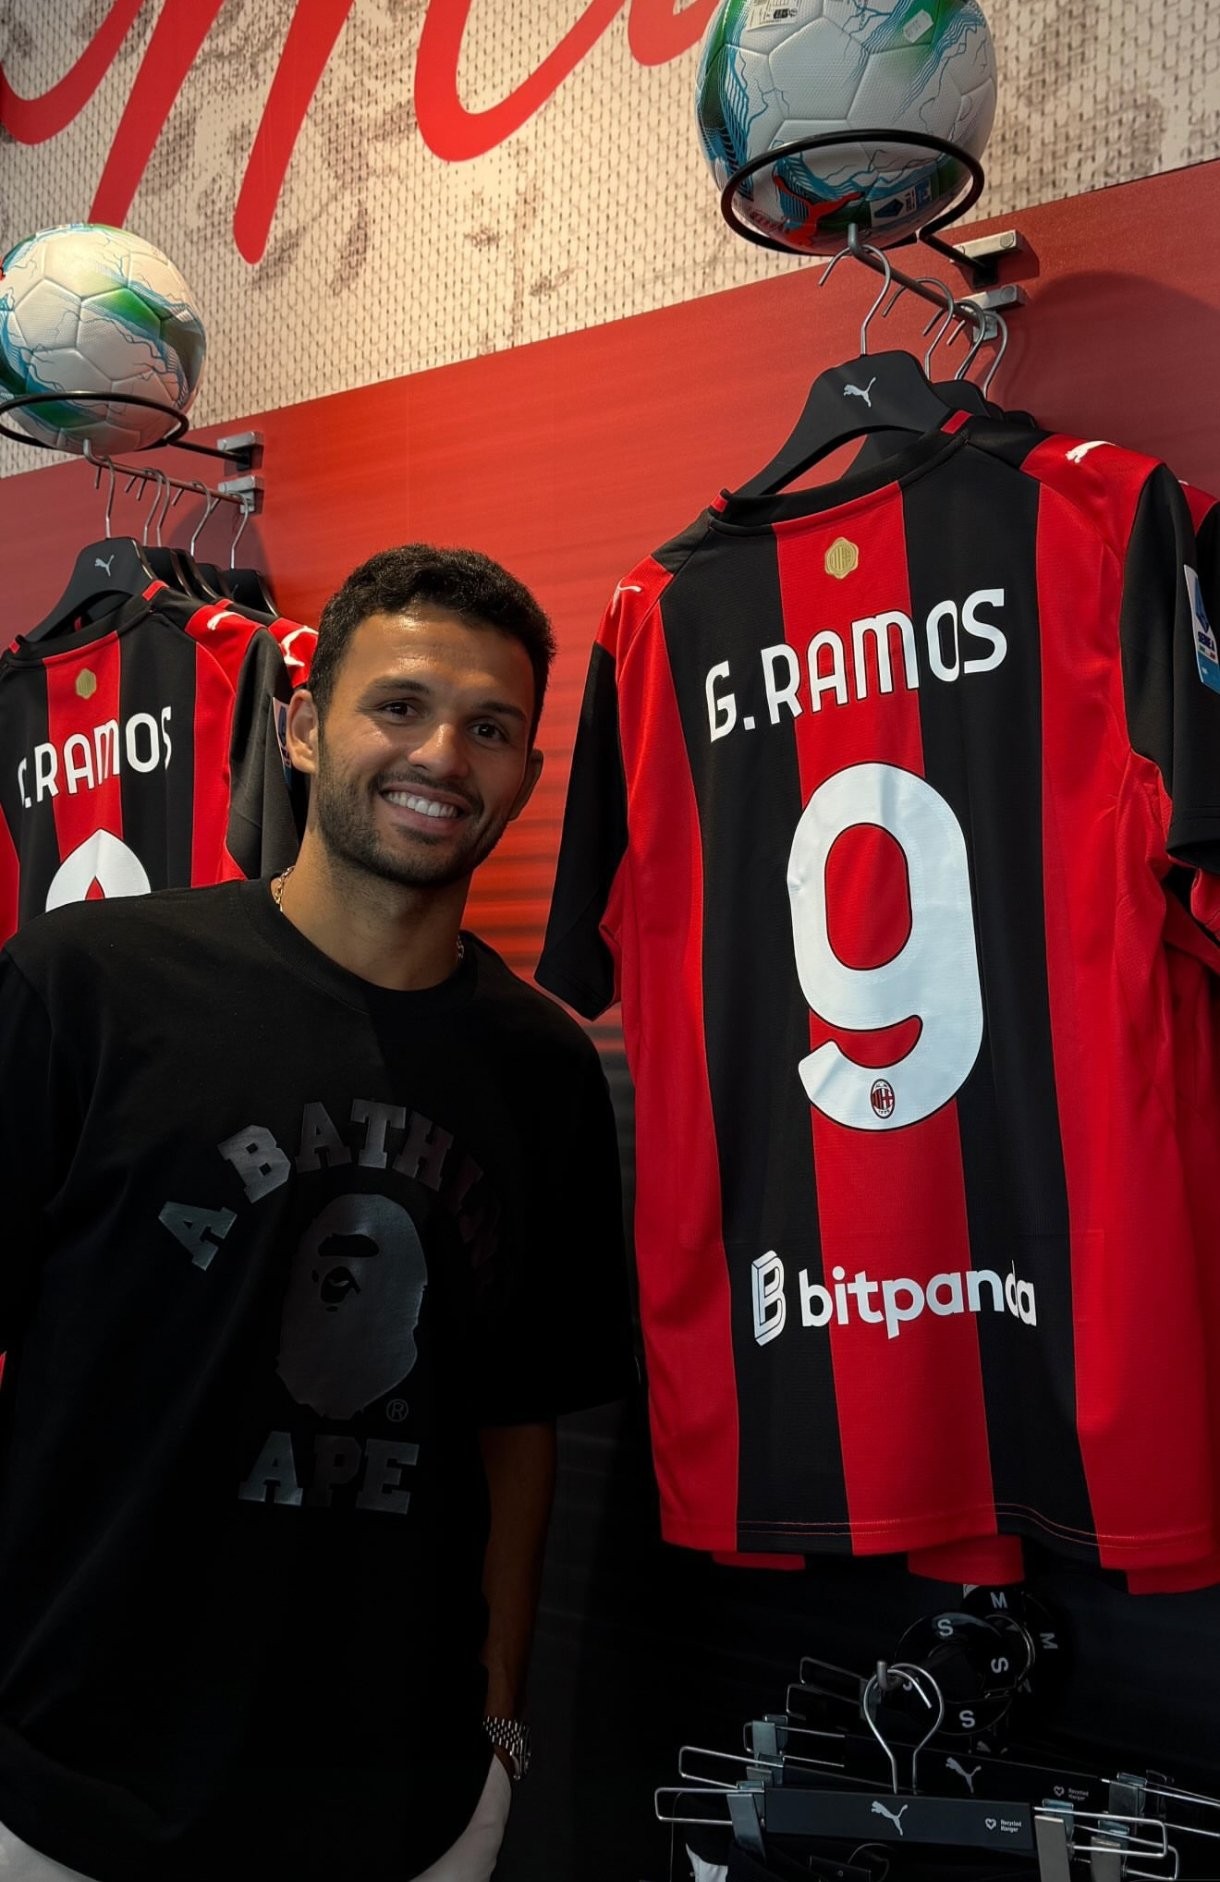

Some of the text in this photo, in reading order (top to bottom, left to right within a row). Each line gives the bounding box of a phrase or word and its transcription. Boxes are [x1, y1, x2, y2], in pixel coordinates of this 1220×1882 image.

[787, 762, 984, 1131] 9
[158, 1201, 238, 1271] A
[798, 1259, 1037, 1340] bitpanda
[238, 1430, 420, 1515] APE
[990, 1591, 1007, 1608] M
[937, 1618, 954, 1637] S
[990, 1657, 1009, 1674] S
[959, 1709, 976, 1728] S
